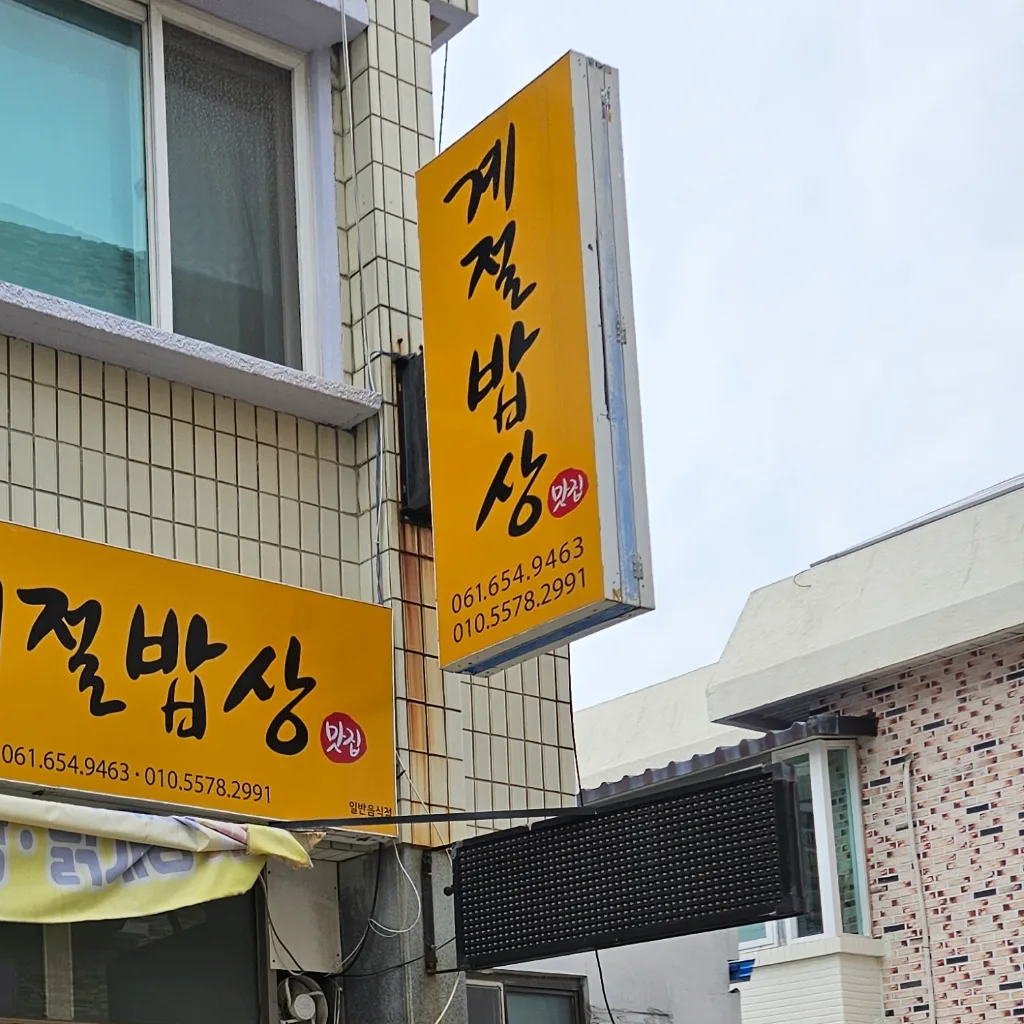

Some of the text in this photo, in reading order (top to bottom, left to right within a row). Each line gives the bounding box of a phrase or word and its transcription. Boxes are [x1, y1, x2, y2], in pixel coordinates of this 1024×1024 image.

[444, 122, 547, 538] 계절밥상
[551, 474, 583, 513] 맛집
[451, 537, 585, 614] 061.654.9463
[453, 567, 587, 644] 010.5578.2991
[326, 721, 361, 757] 맛집
[2, 744, 272, 804] 061.654.9463 010.5578.2991
[348, 801, 392, 817] 일반음식점
